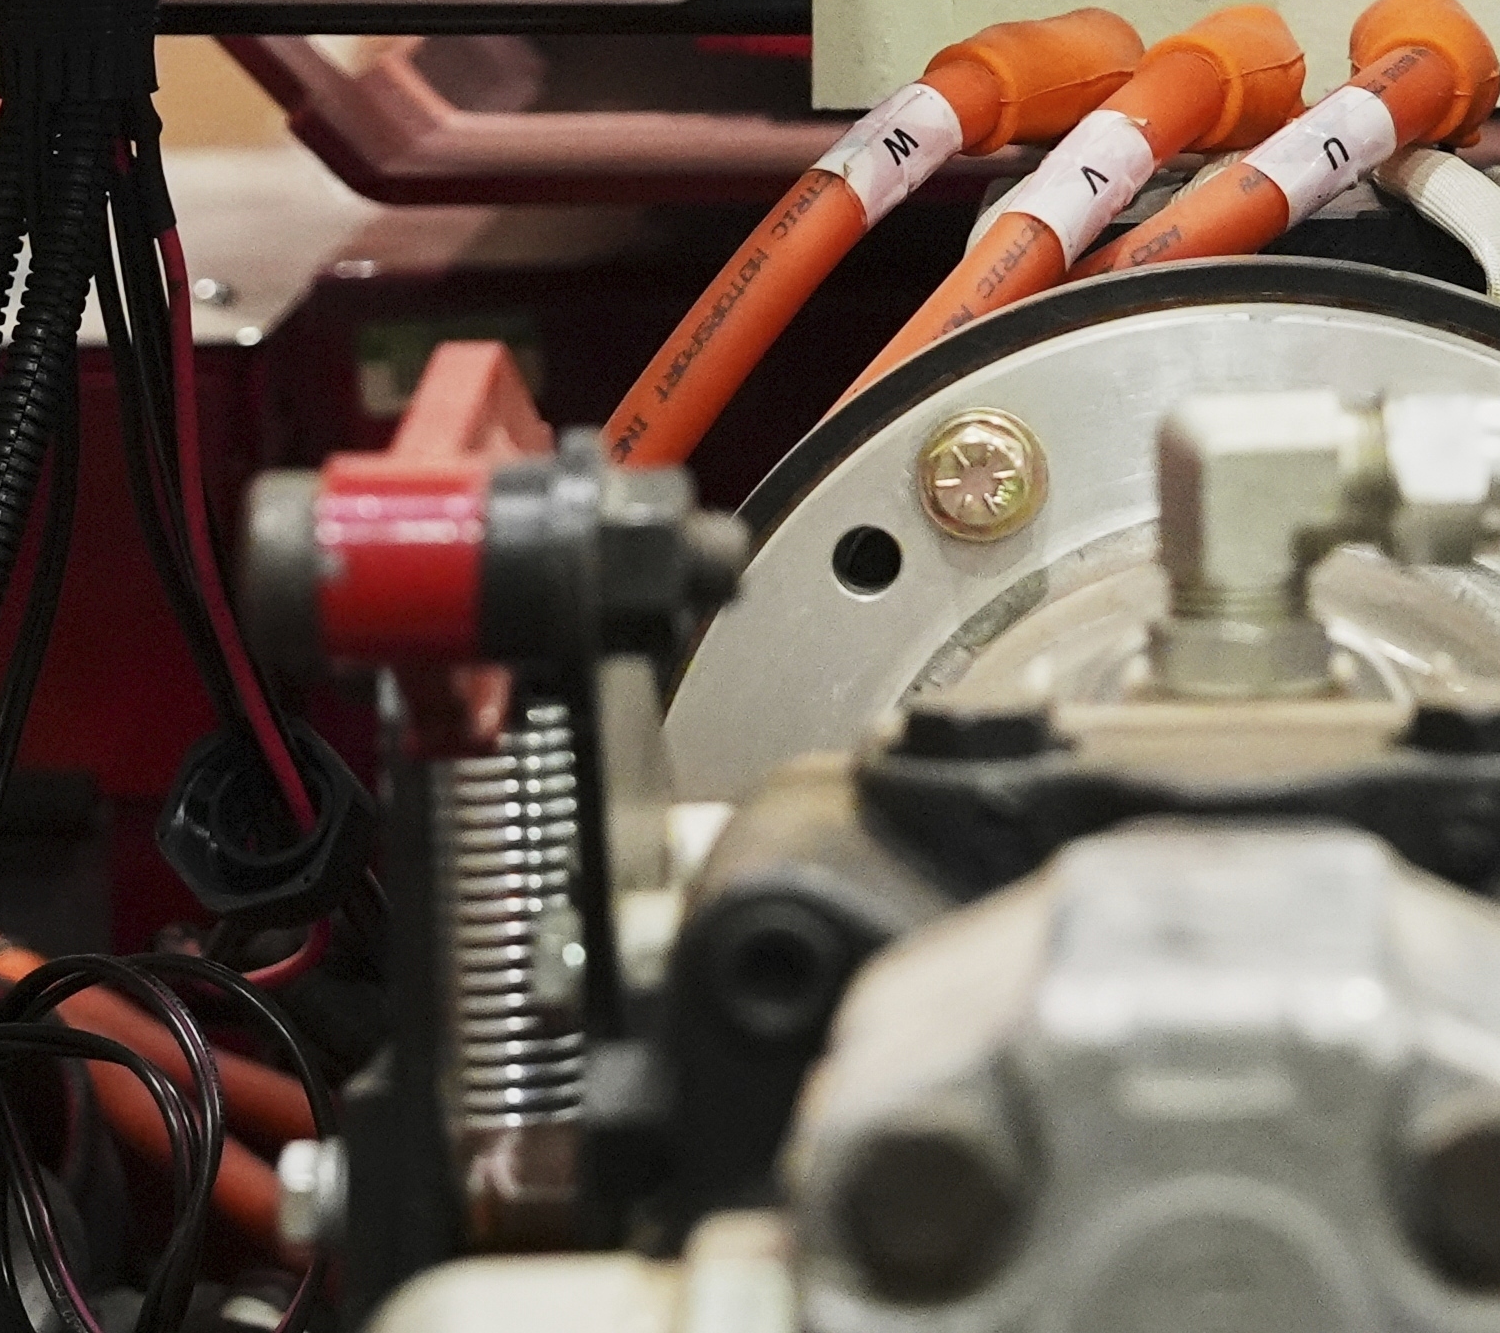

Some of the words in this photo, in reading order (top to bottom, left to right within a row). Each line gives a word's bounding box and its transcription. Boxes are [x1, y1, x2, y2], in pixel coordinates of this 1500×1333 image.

[883, 126, 920, 166] W
[1323, 135, 1349, 169] U
[1080, 165, 1109, 195] V
